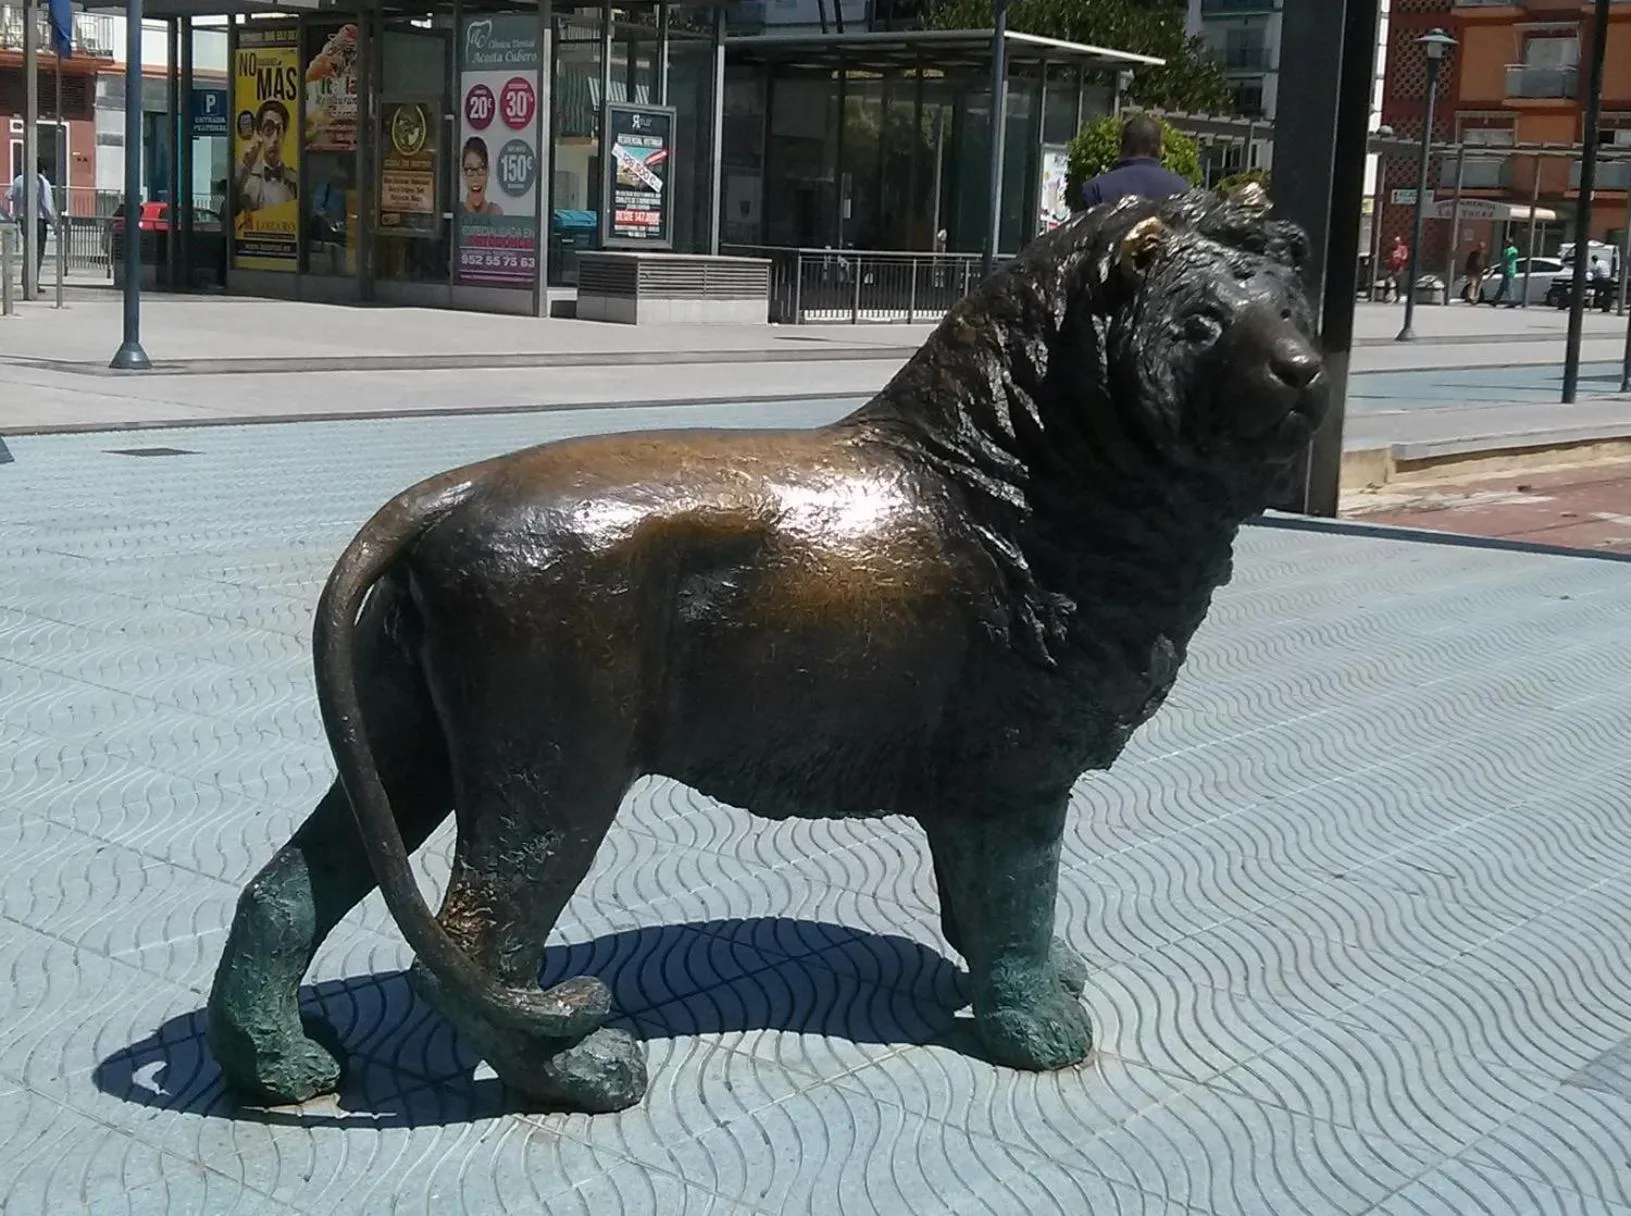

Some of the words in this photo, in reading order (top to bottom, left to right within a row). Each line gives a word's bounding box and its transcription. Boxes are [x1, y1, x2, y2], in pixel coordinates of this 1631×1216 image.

[239, 52, 257, 77] NO
[256, 60, 297, 101] MÁS
[206, 94, 216, 113] P
[461, 254, 484, 265] 952
[486, 256, 501, 267] 55
[520, 257, 536, 269] 63
